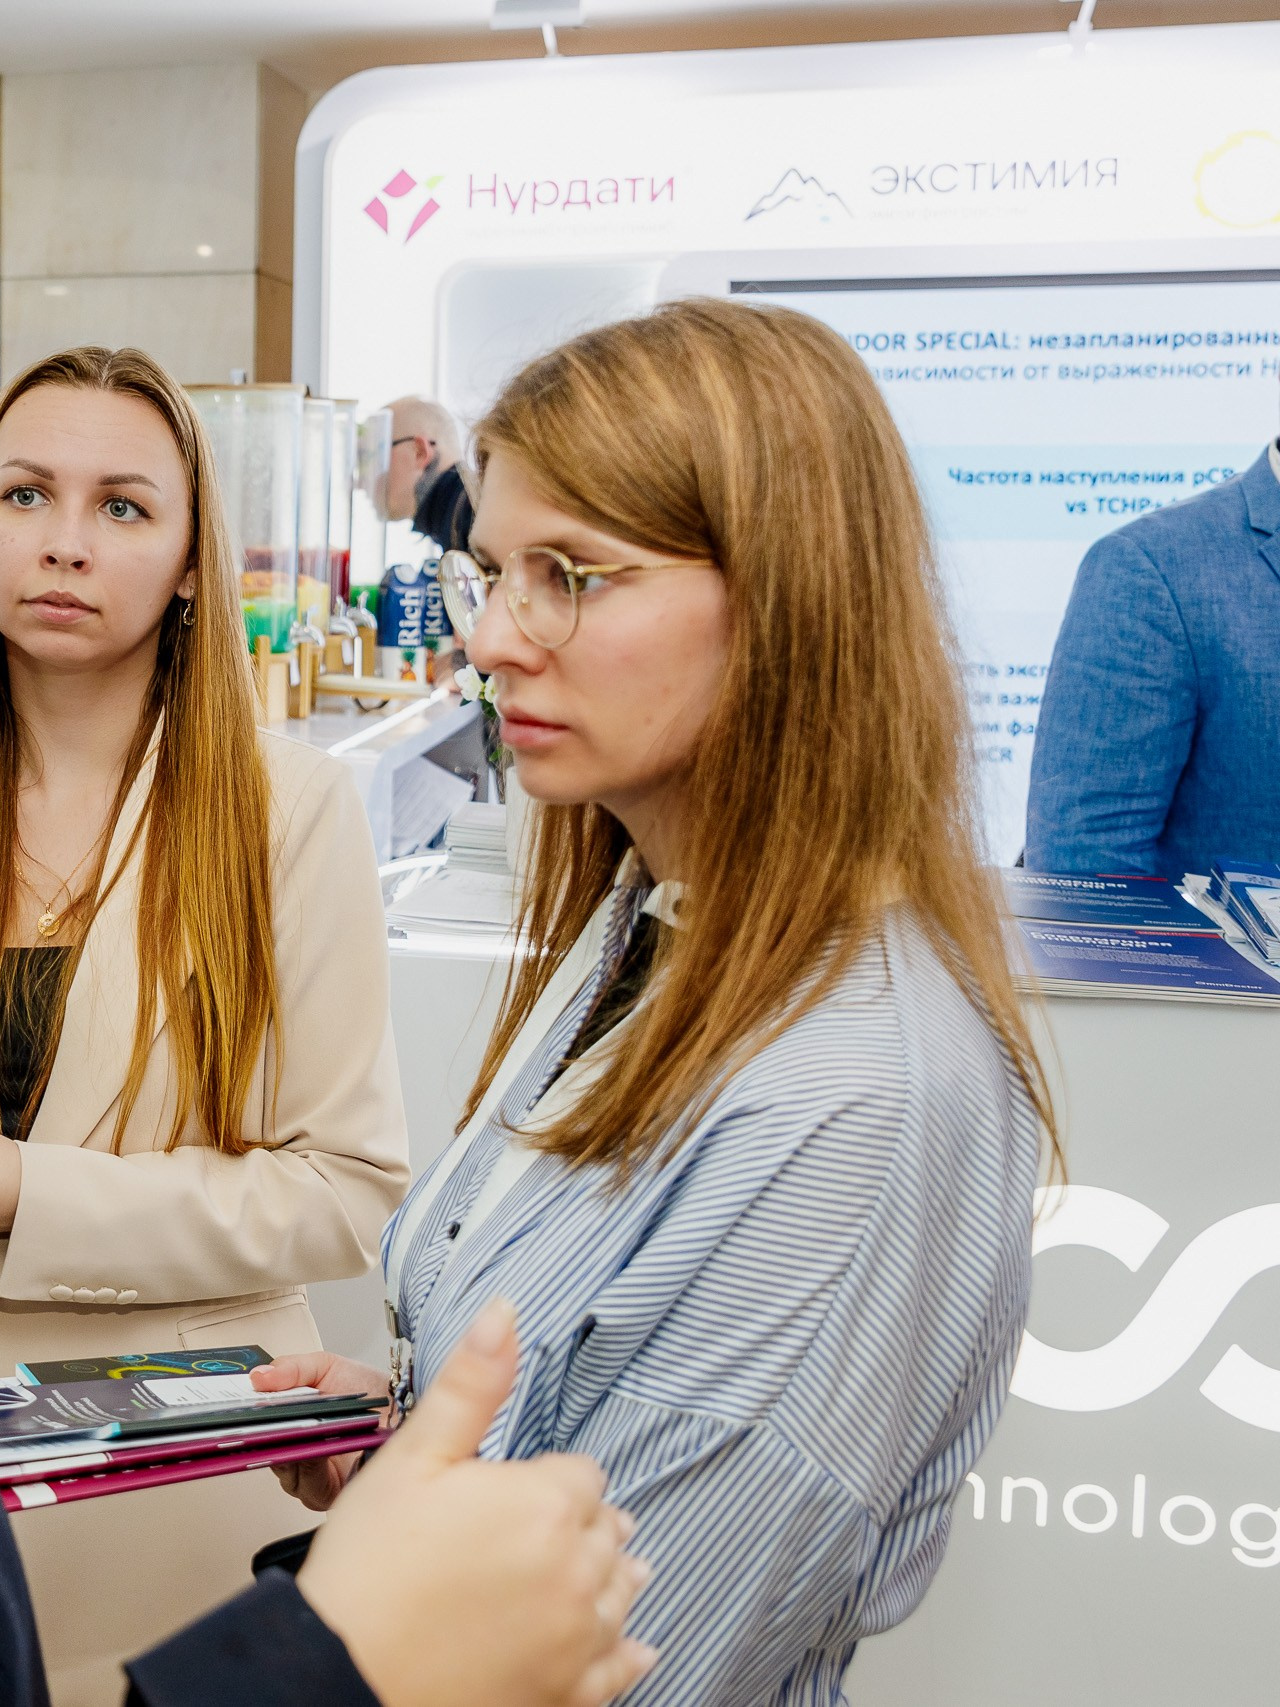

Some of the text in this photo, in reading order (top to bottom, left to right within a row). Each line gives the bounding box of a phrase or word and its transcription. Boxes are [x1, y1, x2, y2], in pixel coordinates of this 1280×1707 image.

[869, 157, 1119, 196] ЭКСТИМИЯ
[466, 173, 676, 215] Нурдати
[916, 332, 1019, 350] SPECIAL:
[1023, 363, 1049, 380] от
[1058, 361, 1252, 382] выраженности
[948, 467, 1032, 485] Частота
[1039, 468, 1185, 487] наступления
[1065, 501, 1087, 514] vs
[397, 589, 422, 646] Rich
